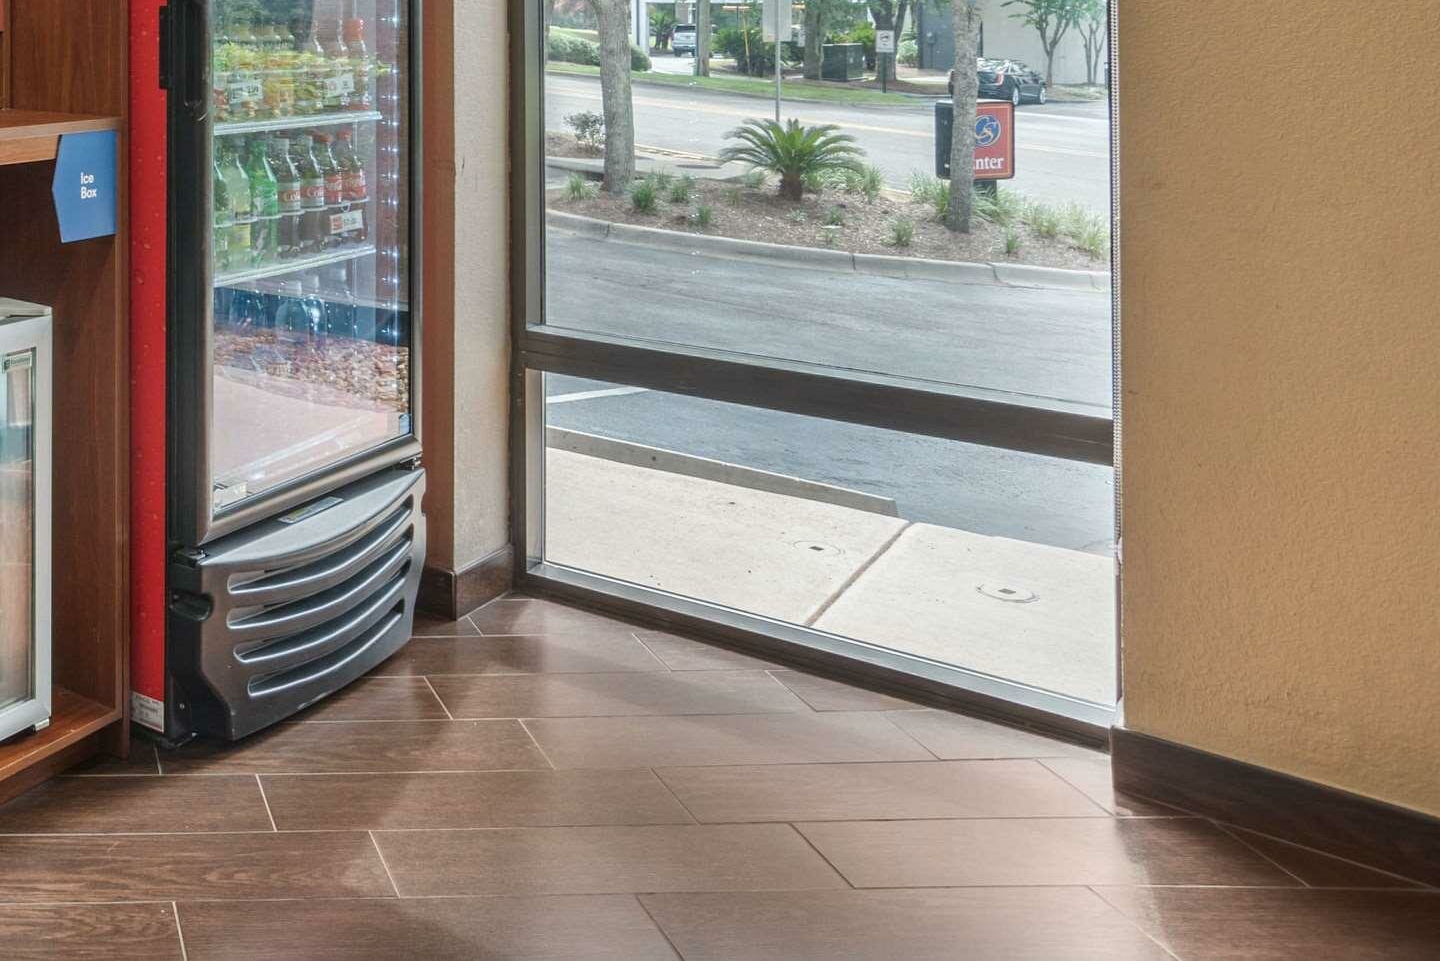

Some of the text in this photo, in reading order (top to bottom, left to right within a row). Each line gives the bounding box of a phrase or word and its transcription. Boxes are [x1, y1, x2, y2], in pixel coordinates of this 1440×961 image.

[973, 156, 1004, 170] nter
[80, 172, 94, 185] Ice
[80, 186, 97, 199] Box
